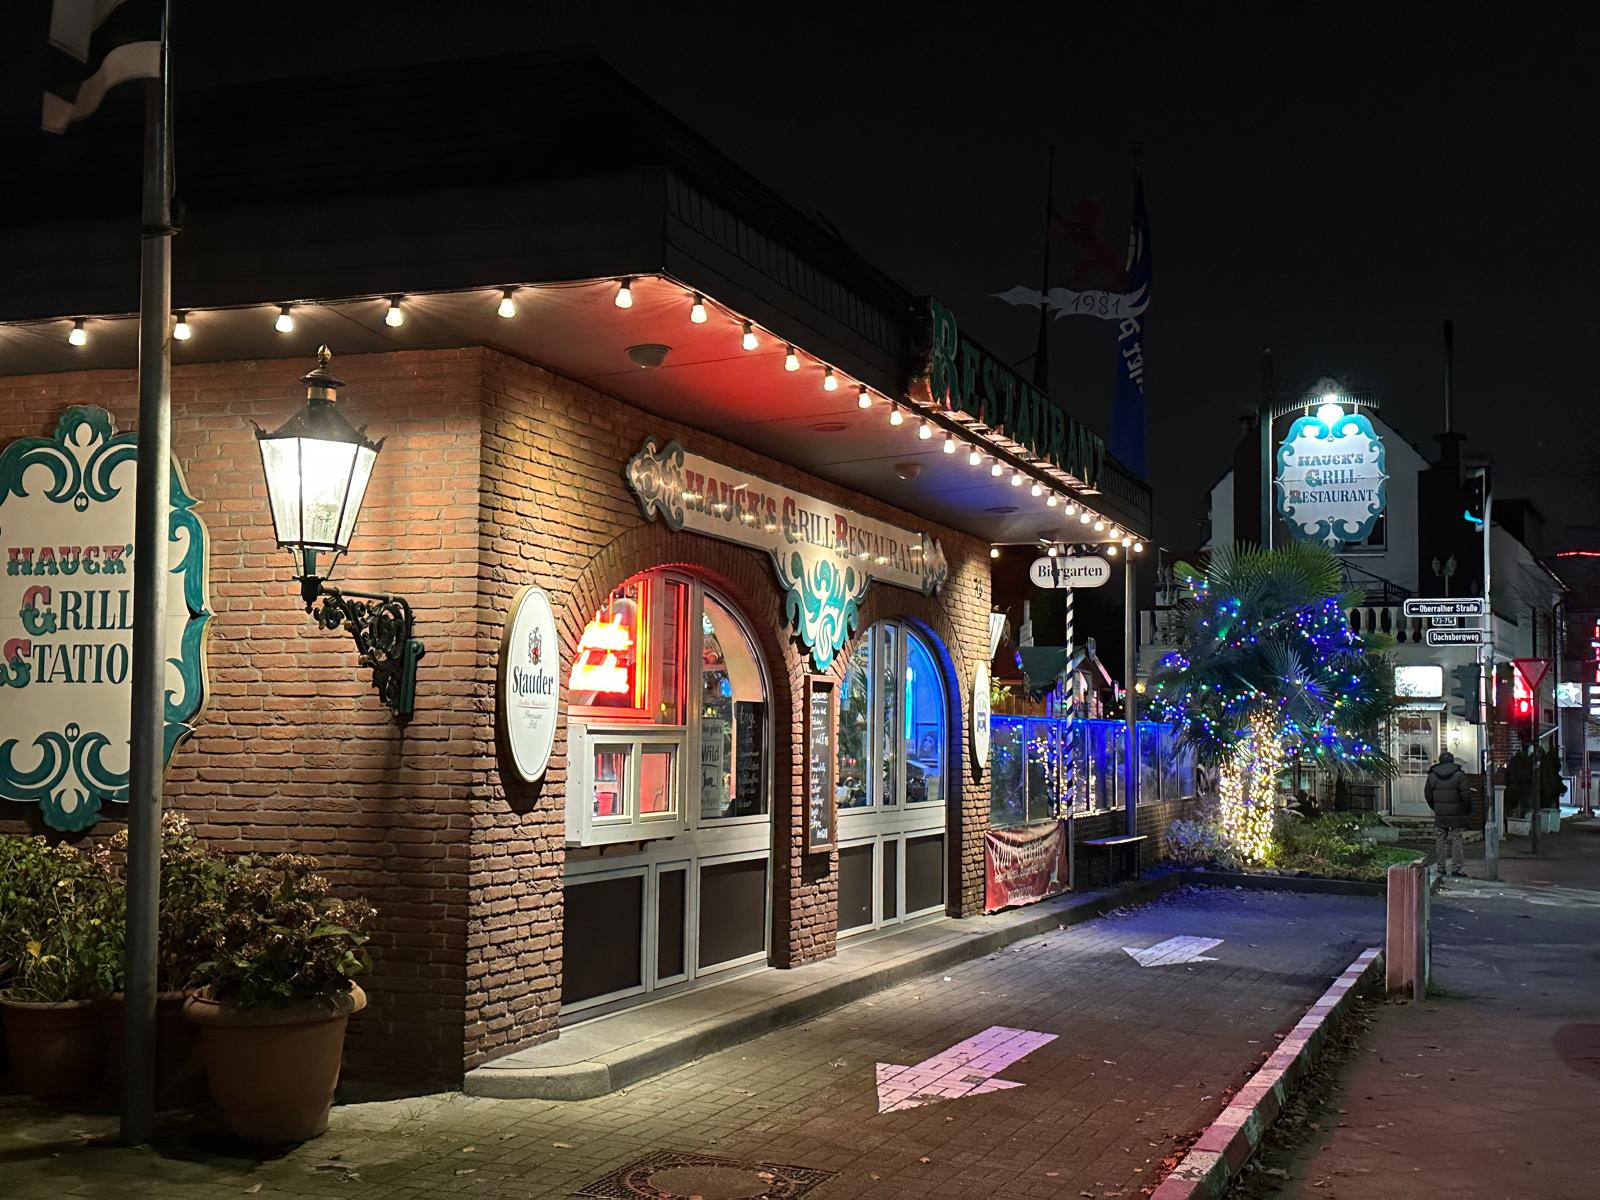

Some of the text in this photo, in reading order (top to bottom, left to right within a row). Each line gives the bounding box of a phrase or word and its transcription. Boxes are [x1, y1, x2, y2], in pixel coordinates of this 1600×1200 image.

[1070, 295, 1121, 316] 1981
[930, 296, 1106, 487] RESTAURANT
[1297, 452, 1364, 467] HAUCK'S
[684, 469, 777, 534] HAUCK'S
[1289, 488, 1374, 504] RESTAURANT
[7, 543, 134, 575] HAUCK'
[1037, 564, 1103, 580] Birgarten
[19, 585, 134, 637] GRILL
[1419, 603, 1478, 613] Oberrather Straße
[1433, 633, 1479, 643] Dachsbergweg
[0, 638, 133, 687] STATIO
[512, 665, 554, 698] Stauder
